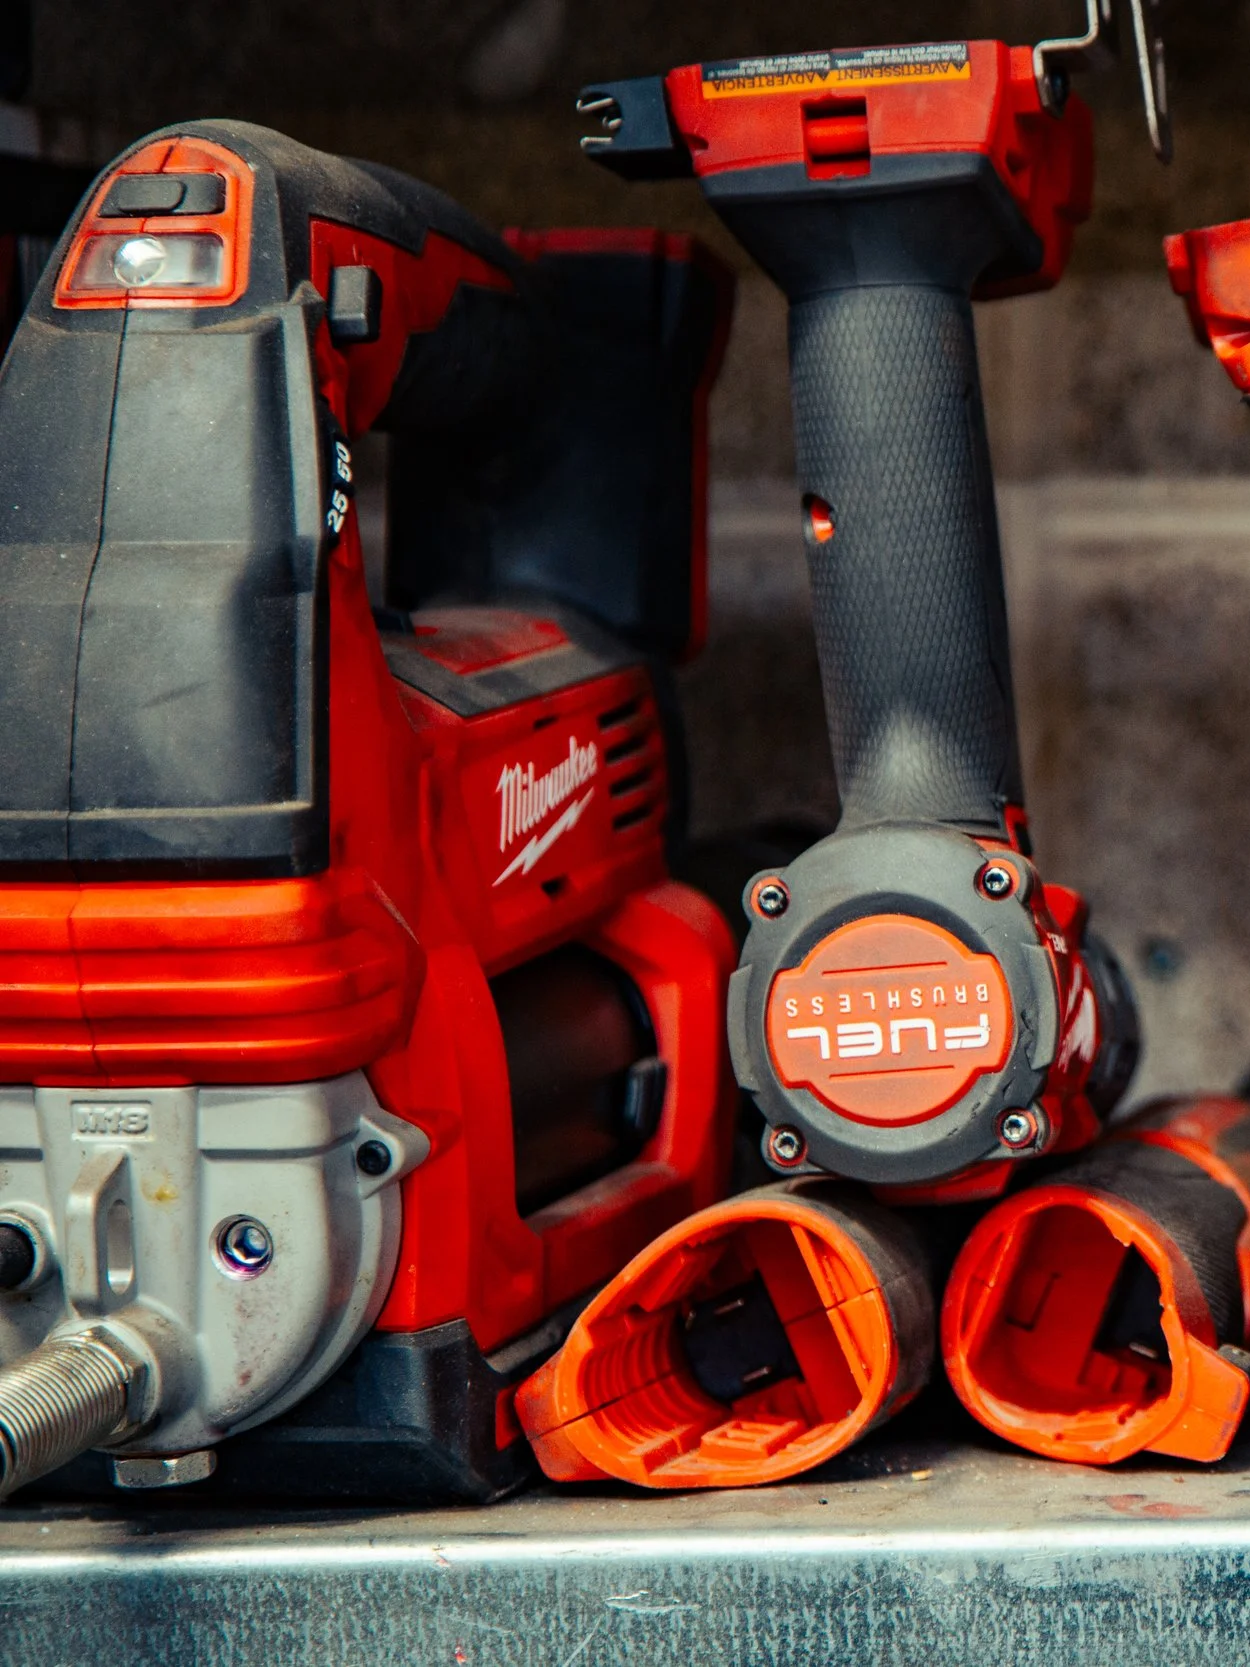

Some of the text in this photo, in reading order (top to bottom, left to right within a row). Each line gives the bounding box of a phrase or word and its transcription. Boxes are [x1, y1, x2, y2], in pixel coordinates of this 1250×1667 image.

[713, 71, 815, 92] ADVERTENCIA
[836, 62, 950, 82] AVERTISSEMENT
[327, 441, 353, 533] 25 50
[495, 735, 598, 853] Milwaukee
[786, 983, 989, 1018] BRUSHLESS
[786, 1013, 992, 1060] FUEL
